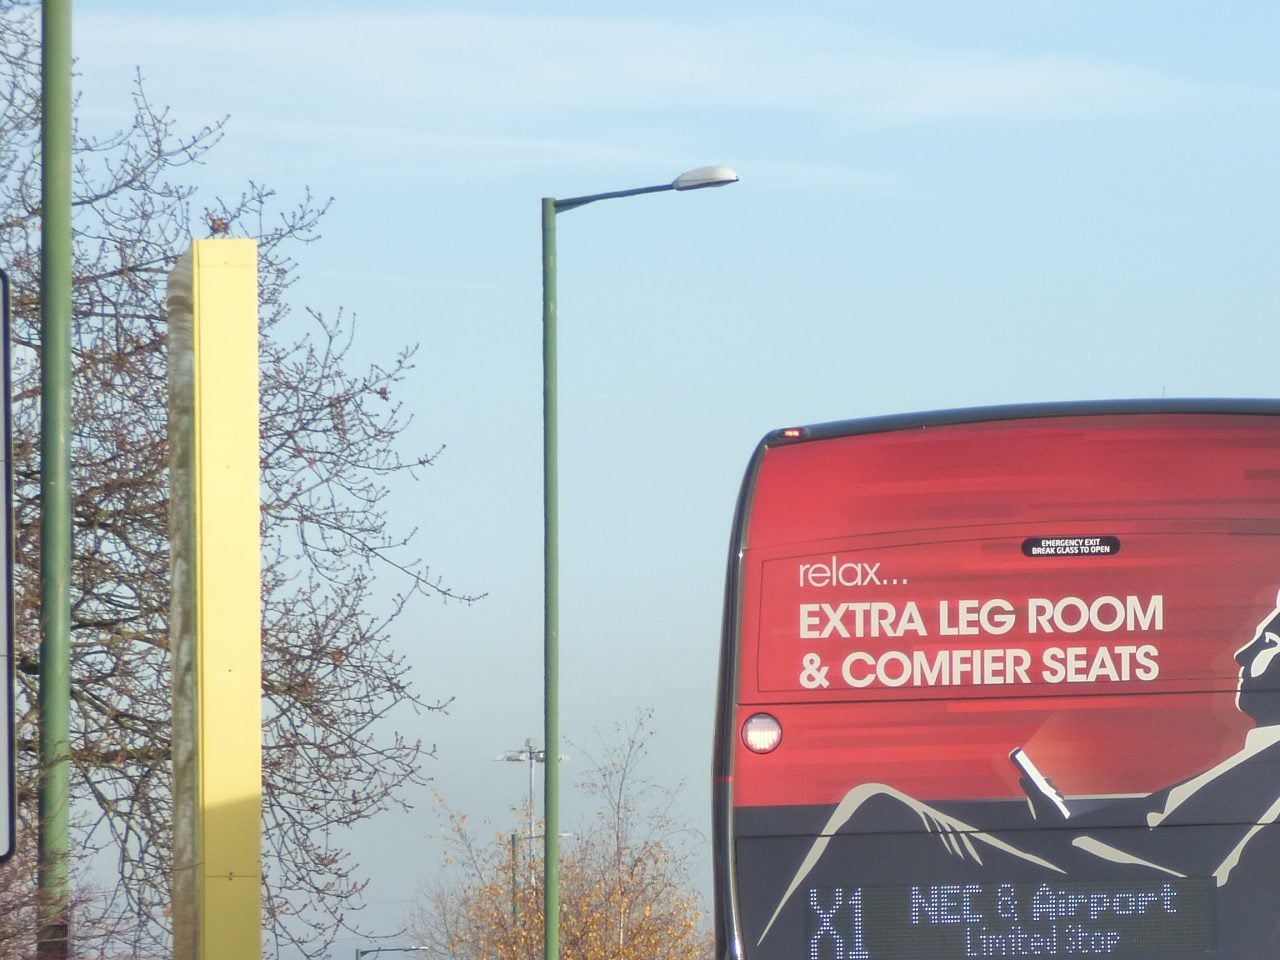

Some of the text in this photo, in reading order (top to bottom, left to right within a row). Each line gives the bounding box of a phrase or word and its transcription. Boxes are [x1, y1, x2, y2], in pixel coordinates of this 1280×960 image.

[1031, 547, 1056, 555] BREAK
[1056, 546, 1079, 554] GLASS
[1090, 545, 1110, 553] OPEN
[1041, 538, 1101, 547] EMERGENCY EXIT
[799, 556, 908, 588] relax...
[799, 595, 1164, 639] EXTRA LEG ROOM
[799, 644, 1160, 689] & COMFIER SEATS
[809, 886, 870, 960] X1
[910, 883, 1178, 925] NEC & Airport
[965, 923, 1121, 957] Limited Stop
